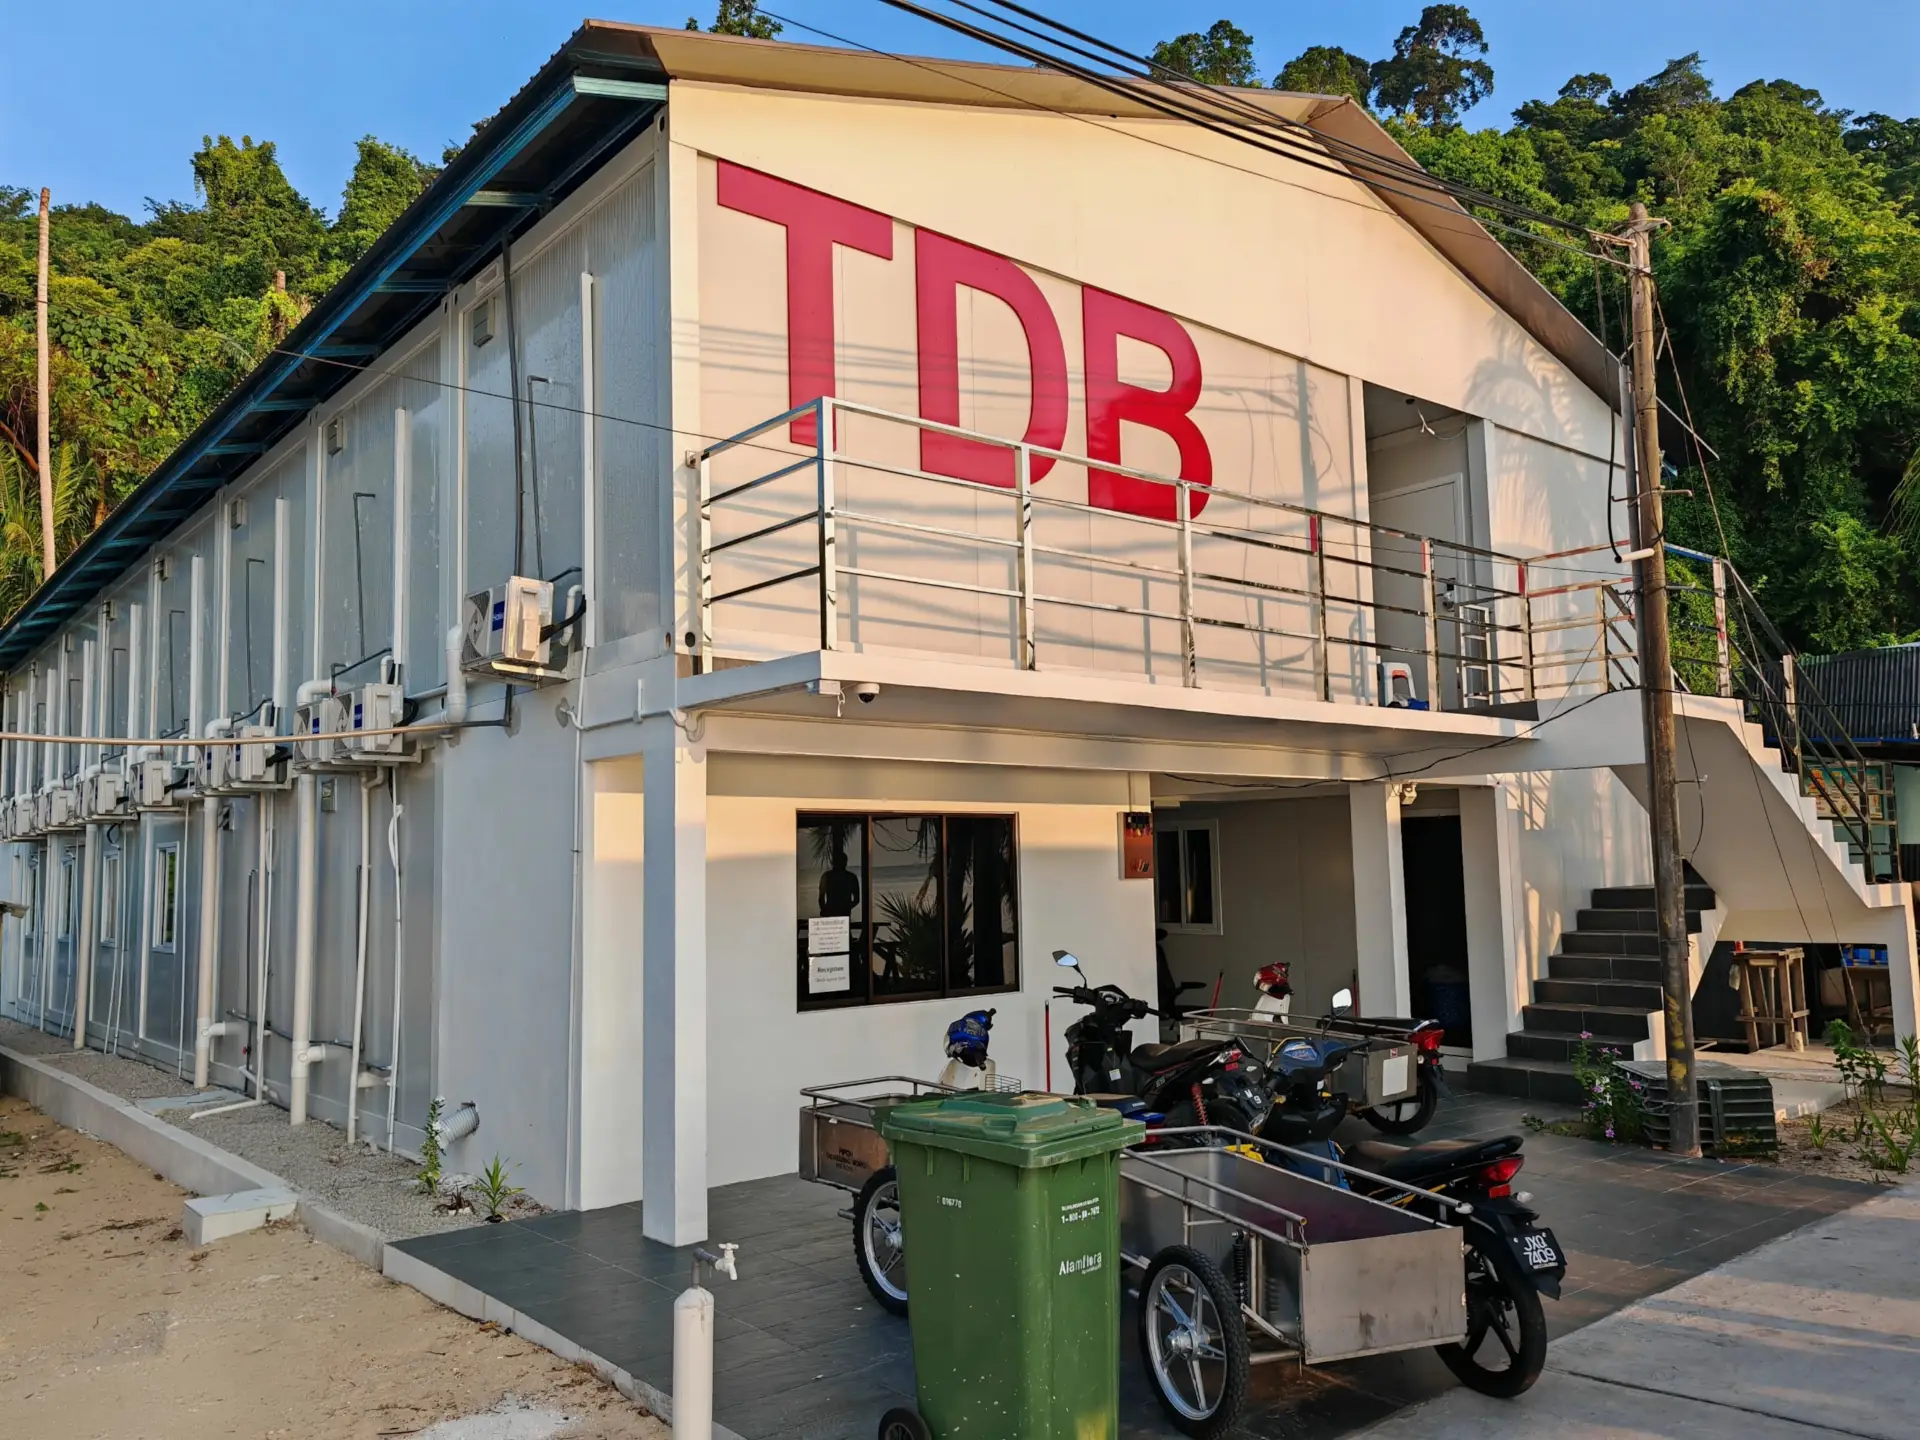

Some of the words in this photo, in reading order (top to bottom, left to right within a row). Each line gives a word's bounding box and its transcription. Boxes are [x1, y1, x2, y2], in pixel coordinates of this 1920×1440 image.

[716, 158, 1214, 523] TDB
[1523, 1235, 1548, 1251] JXQ
[1523, 1247, 1557, 1266] 7409
